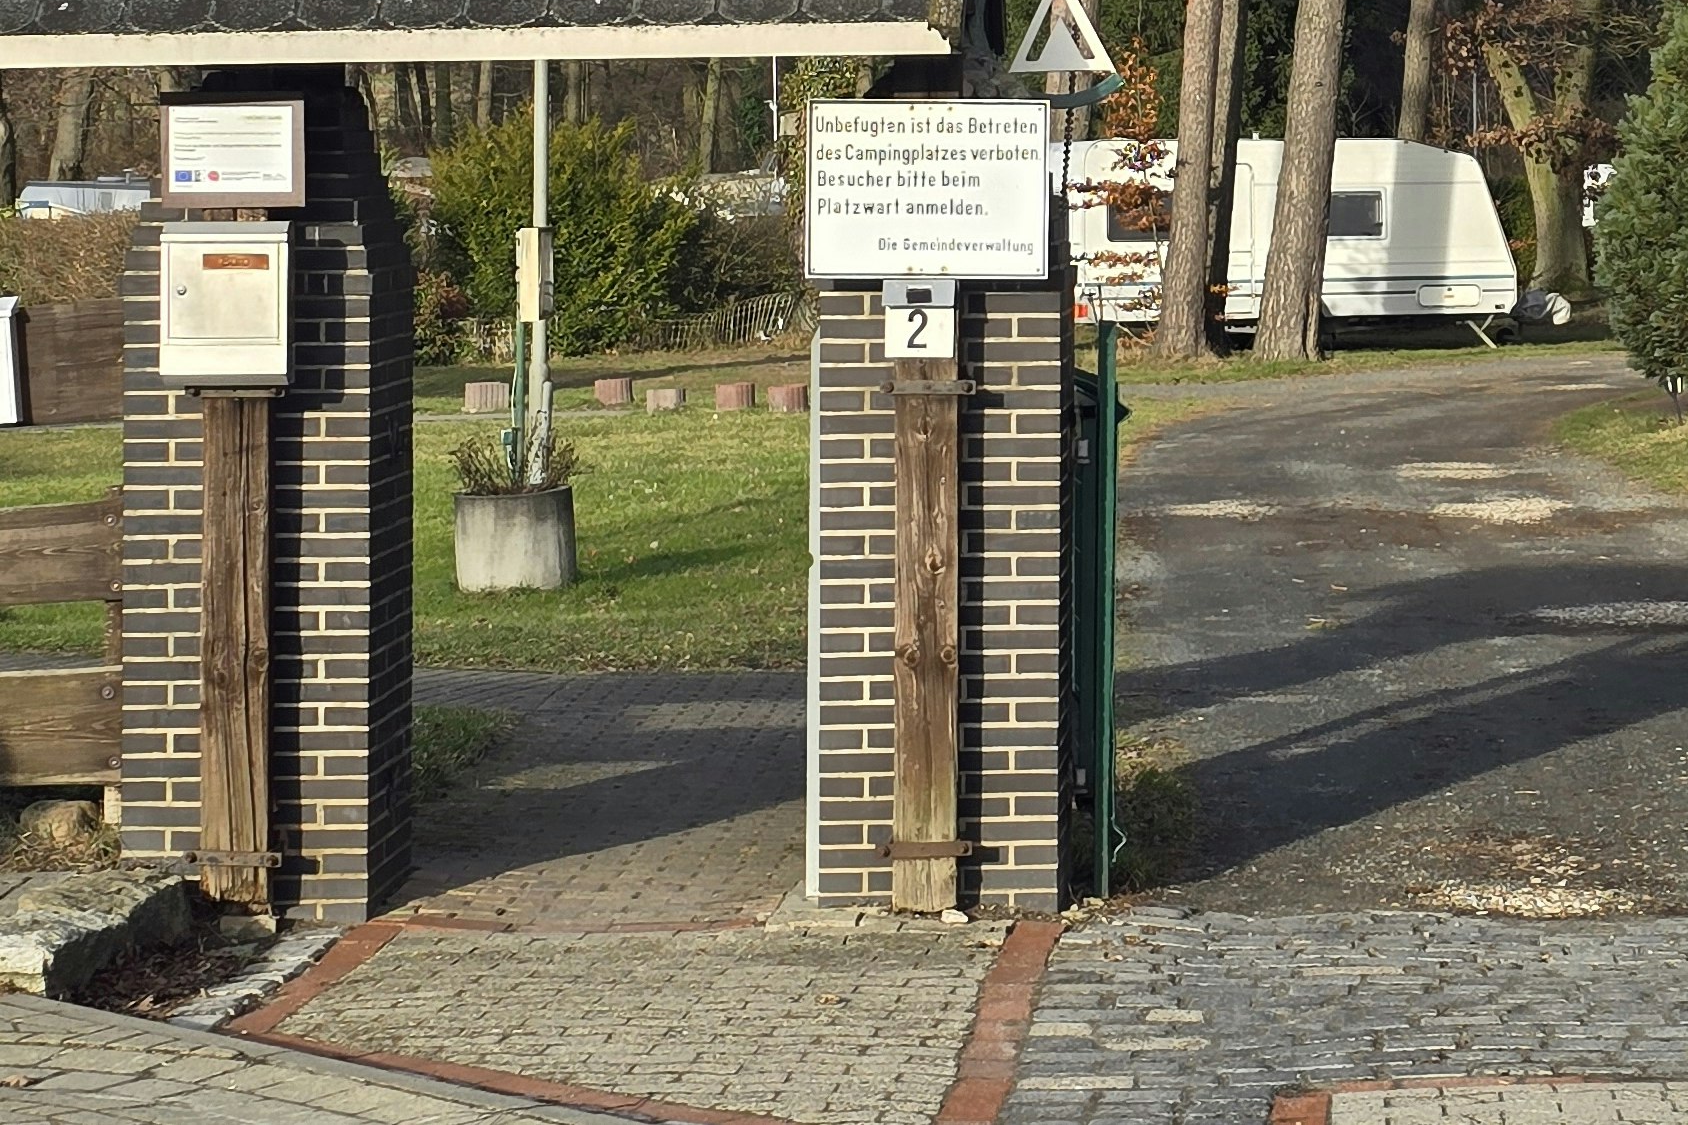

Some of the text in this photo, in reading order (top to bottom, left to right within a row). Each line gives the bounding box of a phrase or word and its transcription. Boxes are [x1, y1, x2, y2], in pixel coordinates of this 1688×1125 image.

[815, 116, 1038, 137] Unbefugten ist das Betreten
[816, 143, 1042, 165] des Campingplatzes verboten.
[817, 170, 981, 187] Besucher bitte beim
[817, 198, 989, 216] Platzwart anmelden.
[878, 238, 1034, 256] Die Gemeindeverwaltung
[906, 308, 929, 349] 2
